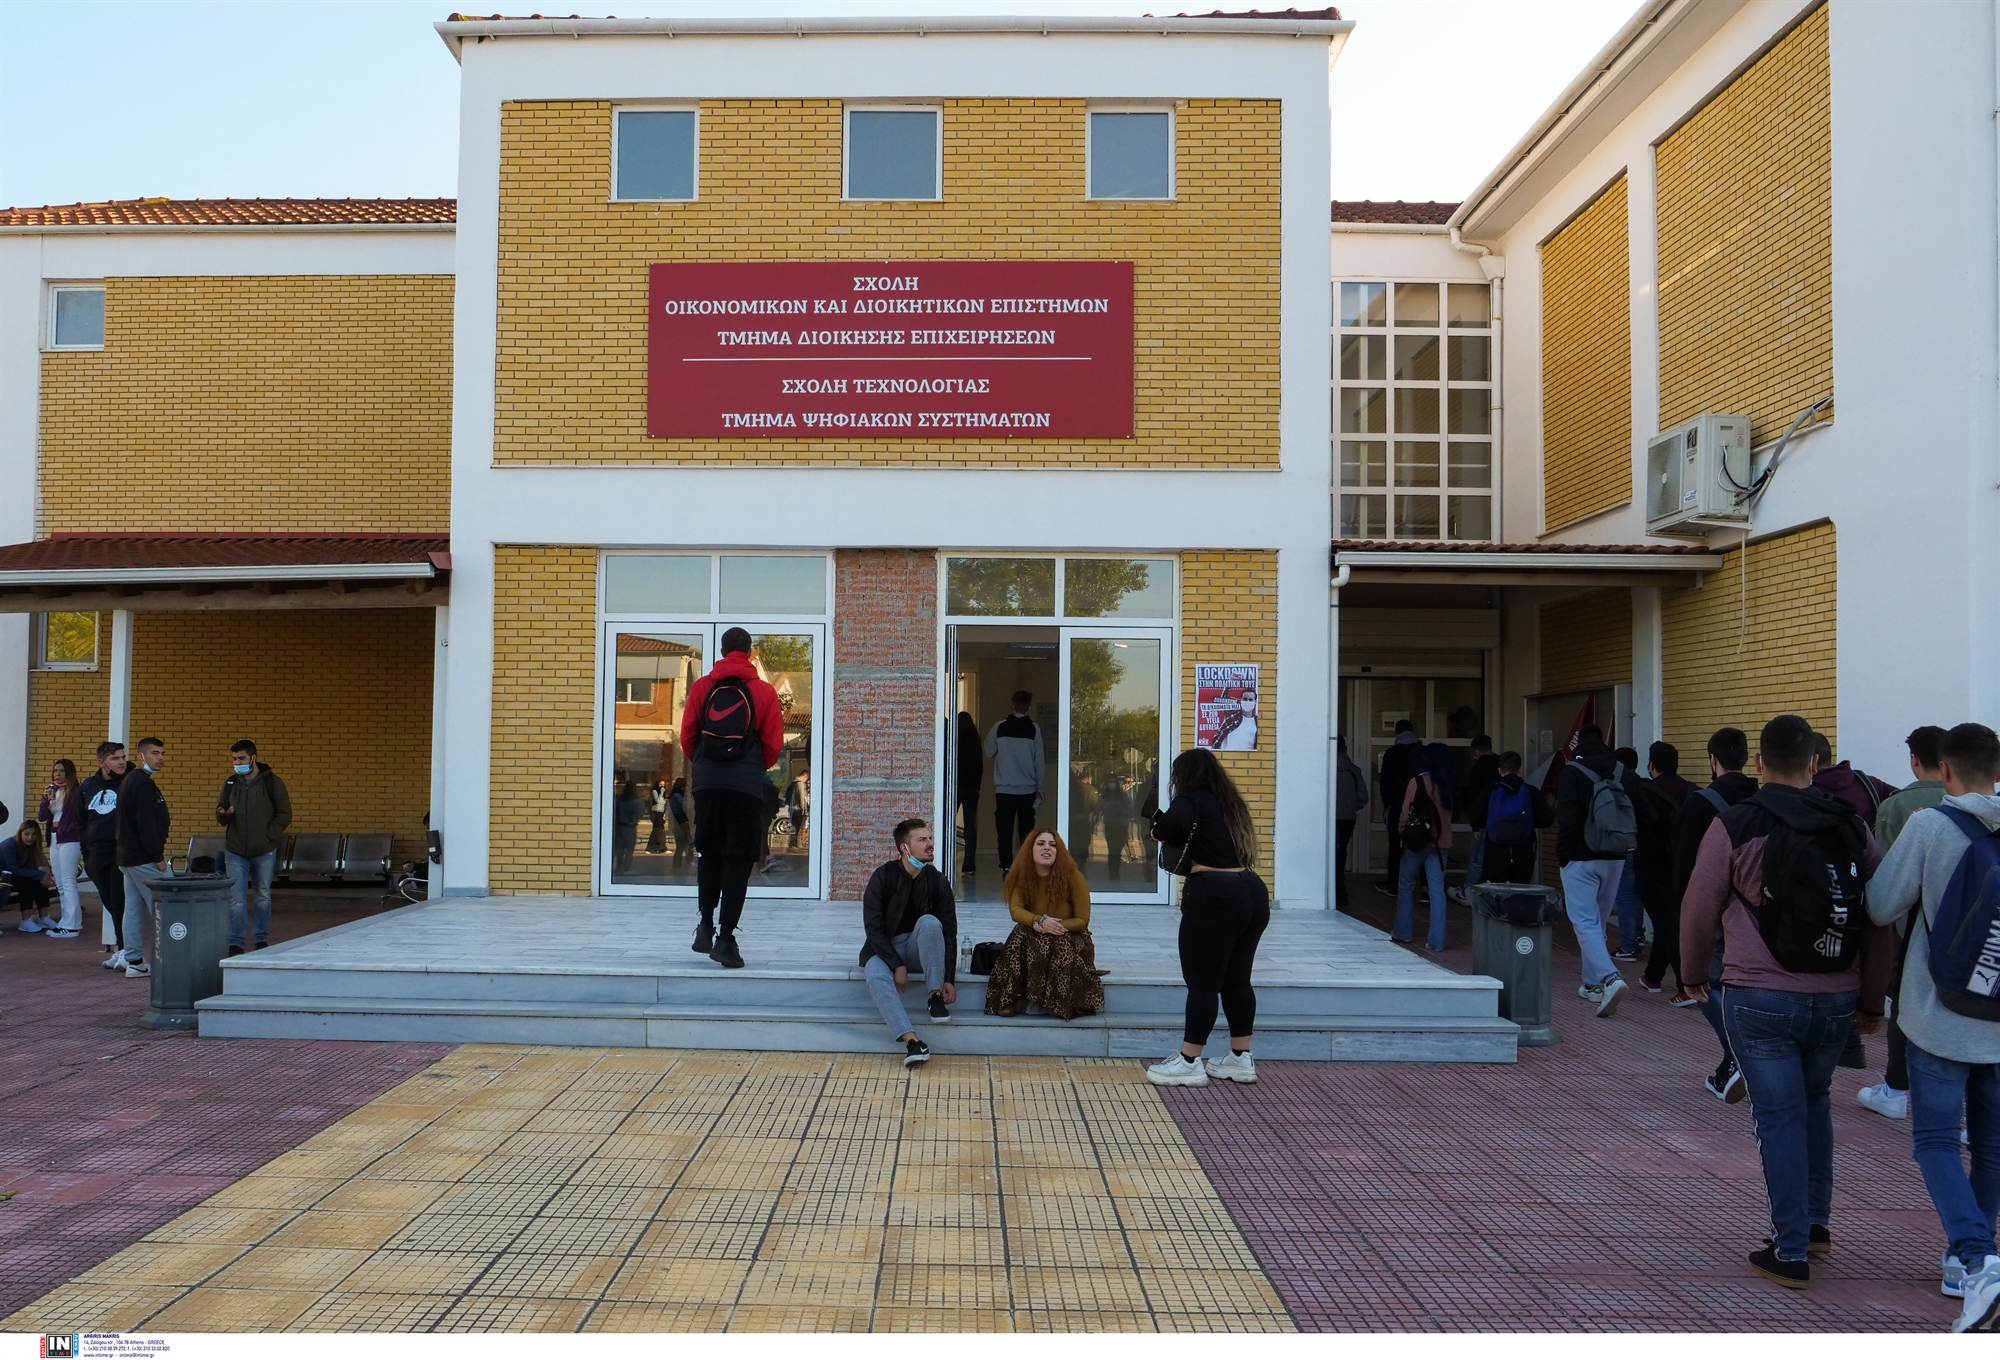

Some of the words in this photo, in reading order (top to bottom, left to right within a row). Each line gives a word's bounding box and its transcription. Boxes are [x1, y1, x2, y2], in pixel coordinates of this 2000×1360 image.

[853, 276, 919, 291] ΣΧΟΛΗ
[665, 299, 808, 315] ΟΙΚΟΝΟΜΙΚΩΝ
[813, 299, 848, 314] ΚΑΙ
[853, 298, 985, 314] ΔΙΟΙΚΗΤΙΚΩΝ
[990, 298, 1109, 314] ΕΠΙΣΤΗΜΩΝ
[717, 330, 793, 346] ΤΜΗΜΑ
[797, 330, 906, 345] ΔΙΟΙΚΗΣΗΣ
[910, 329, 1056, 345] ΕΠΙΧΕΙΡΗΣΕΩΝ
[781, 378, 848, 394] ΣΧΟΛΗ
[852, 378, 990, 394] ΤΕΧΝΟΛΟΓΙΑΣ
[721, 412, 797, 428] ΤΜΗΜΑ
[801, 412, 913, 428] ΨΗΦΙΑΚΩΝ
[917, 412, 1051, 428] ΣΥΣΤΗΜΑΤΩΝ
[1214, 680, 1240, 688] ΠΟΛΙΤΙΚΗ
[1242, 680, 1256, 688] ΤΟΥΣ
